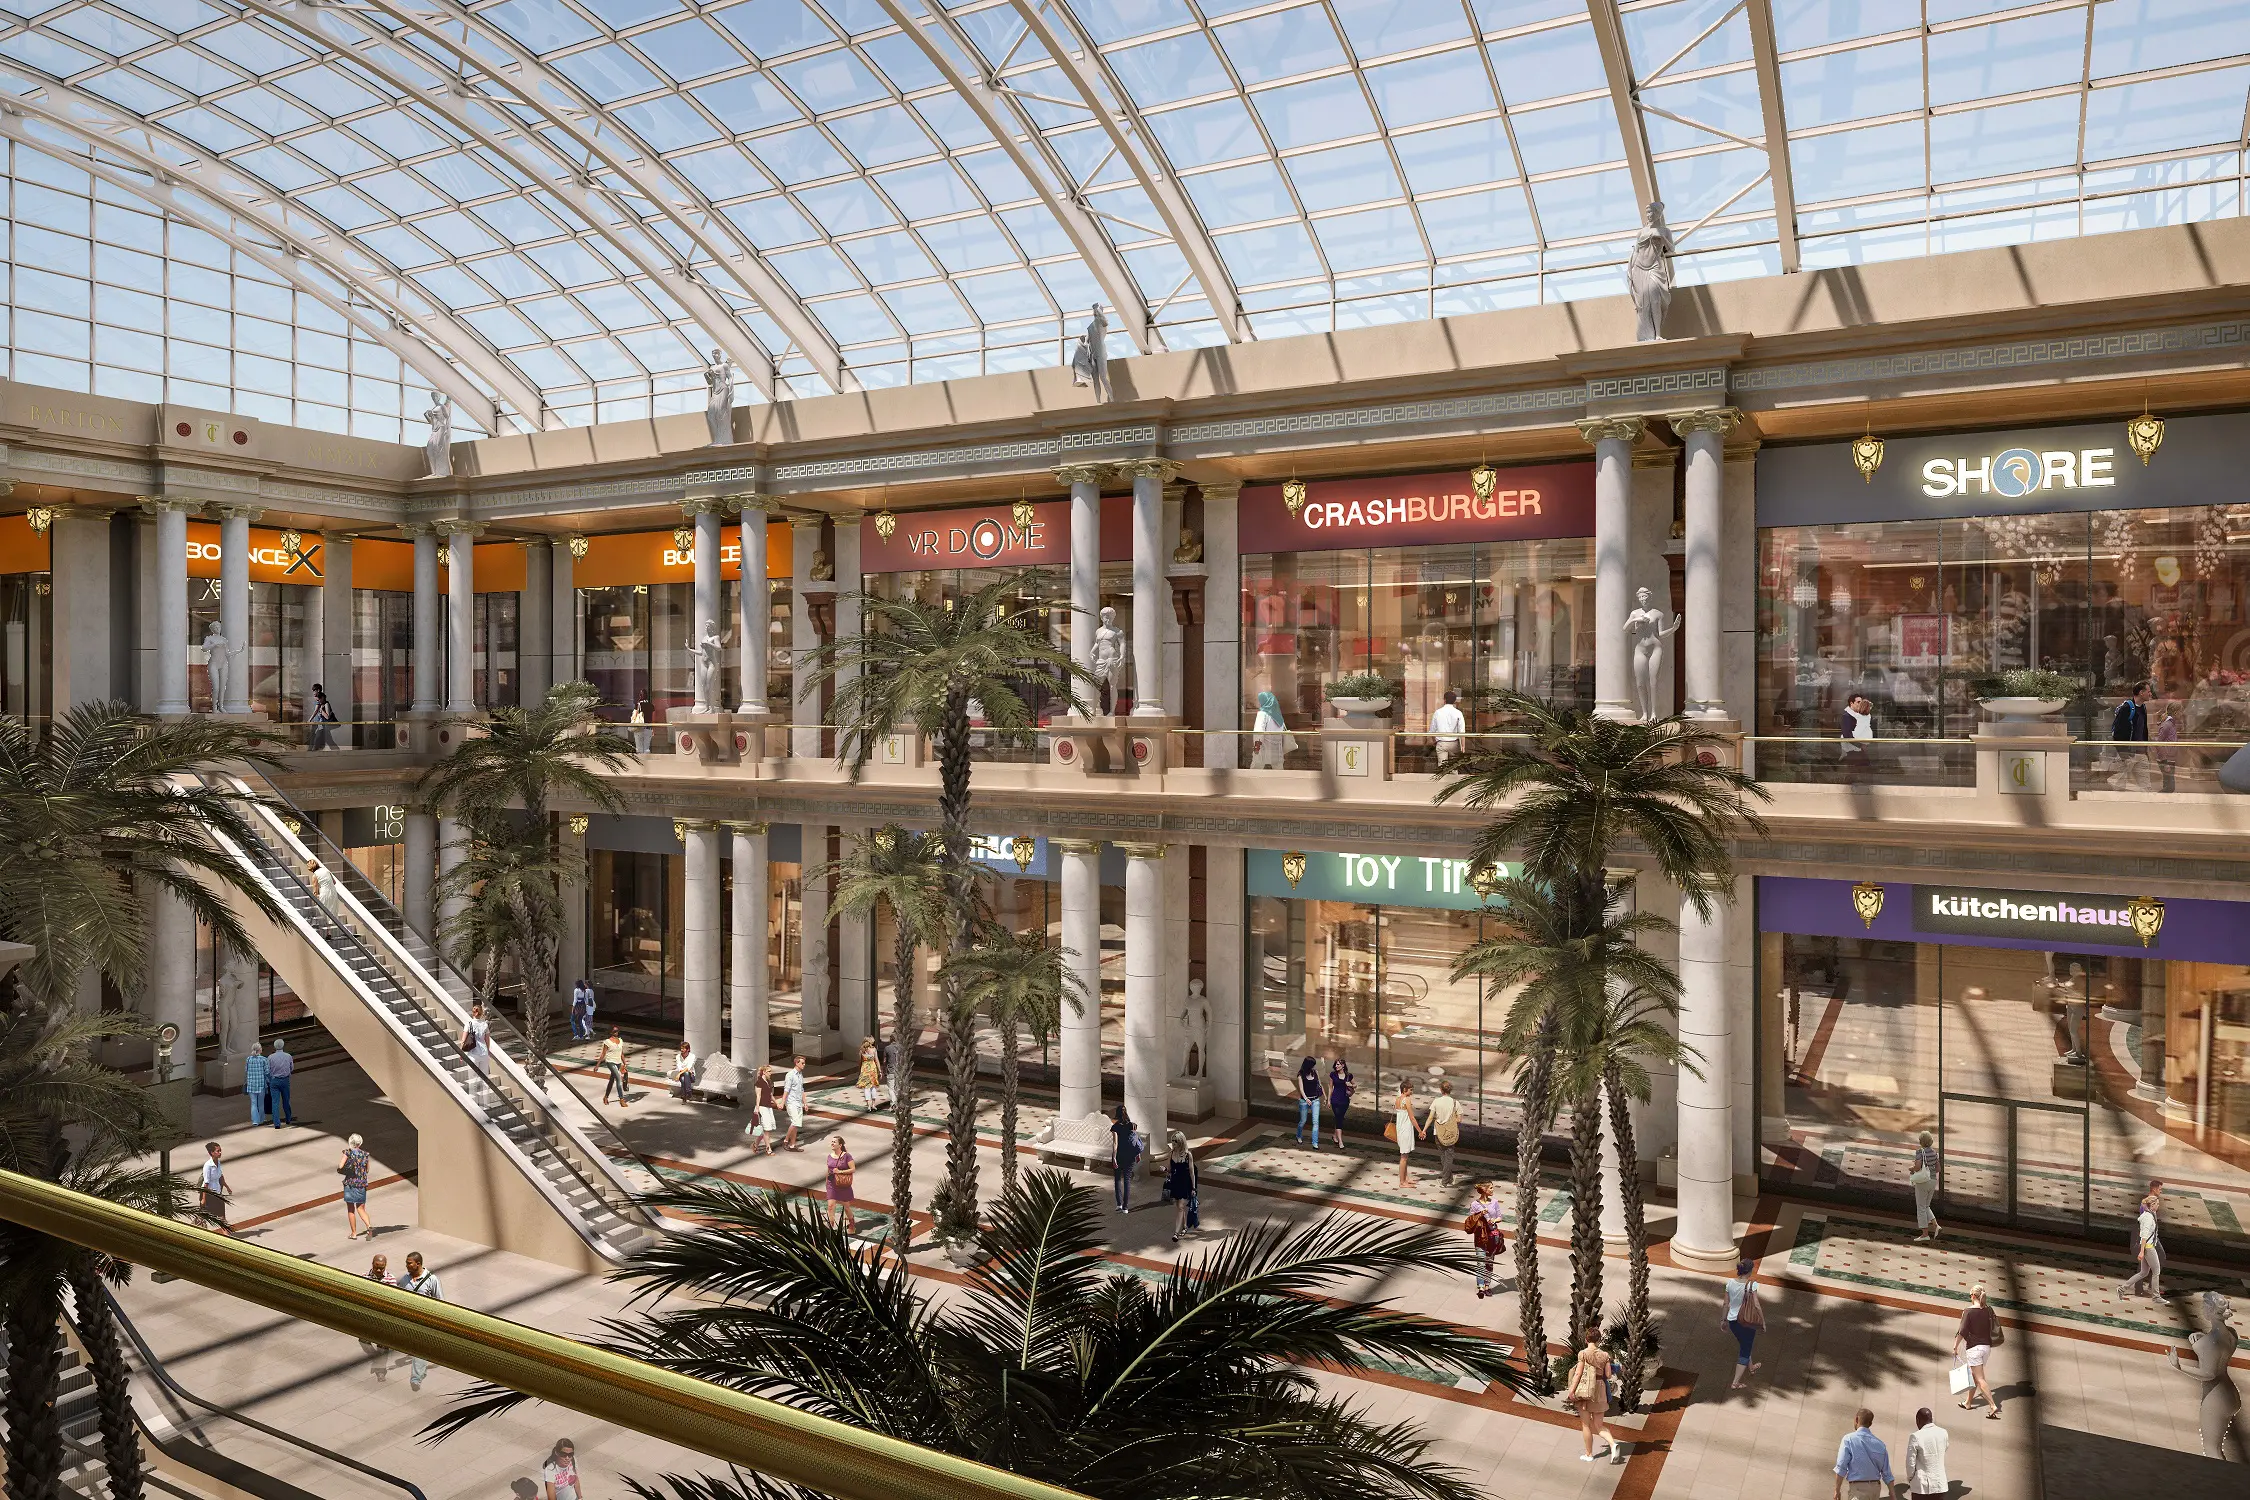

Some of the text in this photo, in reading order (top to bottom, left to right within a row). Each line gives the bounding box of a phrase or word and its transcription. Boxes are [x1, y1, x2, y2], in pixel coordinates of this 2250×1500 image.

[30, 405, 124, 433] BARTON
[1921, 447, 2116, 498] SHORE
[1303, 489, 1542, 529] CRASHBURGER
[908, 517, 1045, 560] VR DOME
[1338, 852, 1402, 890] TOY
[1931, 894, 2133, 927] kütchenhaus
